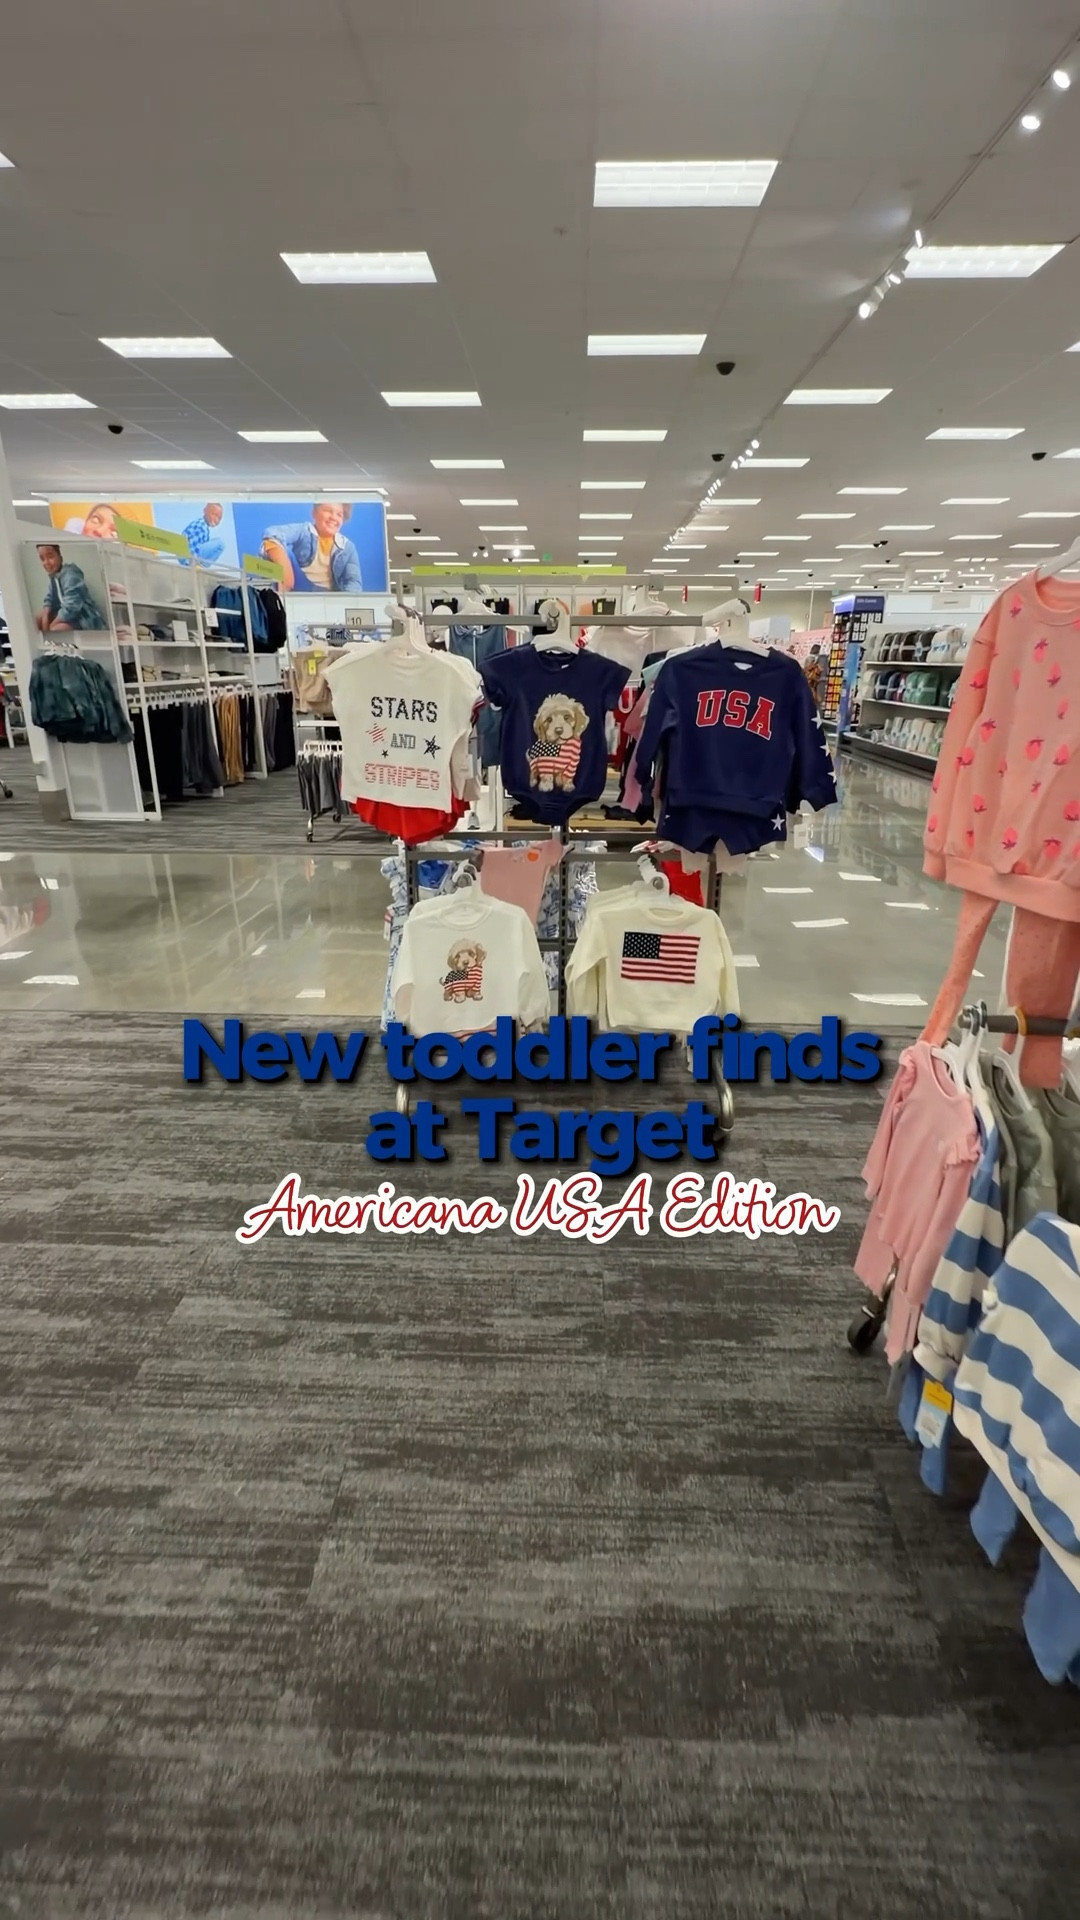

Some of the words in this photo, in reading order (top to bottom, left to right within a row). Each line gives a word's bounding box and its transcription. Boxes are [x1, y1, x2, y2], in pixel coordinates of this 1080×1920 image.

[371, 696, 438, 723] STARS
[696, 690, 775, 741] USA
[390, 733, 416, 750] AND
[364, 763, 440, 791] STRIPES
